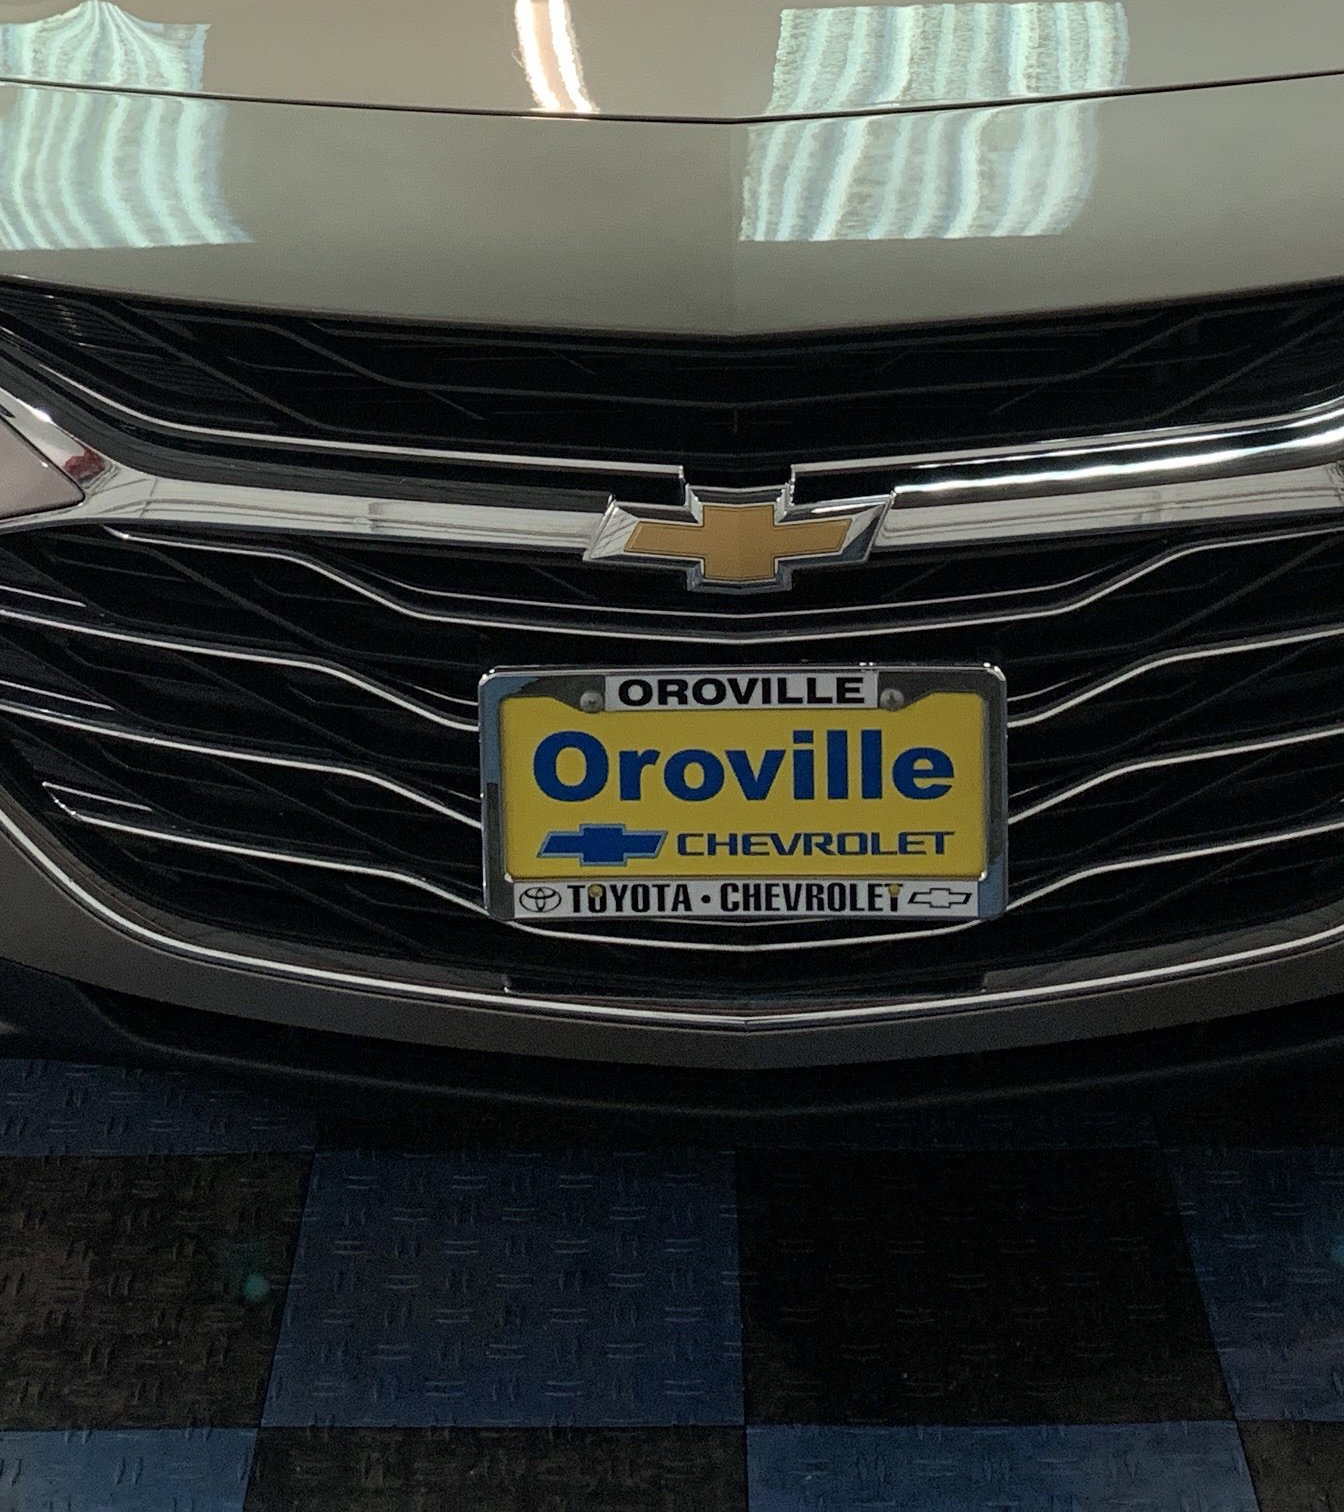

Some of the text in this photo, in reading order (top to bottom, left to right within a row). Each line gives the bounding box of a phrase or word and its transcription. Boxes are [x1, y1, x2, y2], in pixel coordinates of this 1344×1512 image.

[618, 676, 865, 707] OROVILLE
[532, 729, 956, 803] Oroville
[676, 831, 955, 857] CHEVROLET
[567, 882, 903, 914] TOYOTA CHEVROLET
